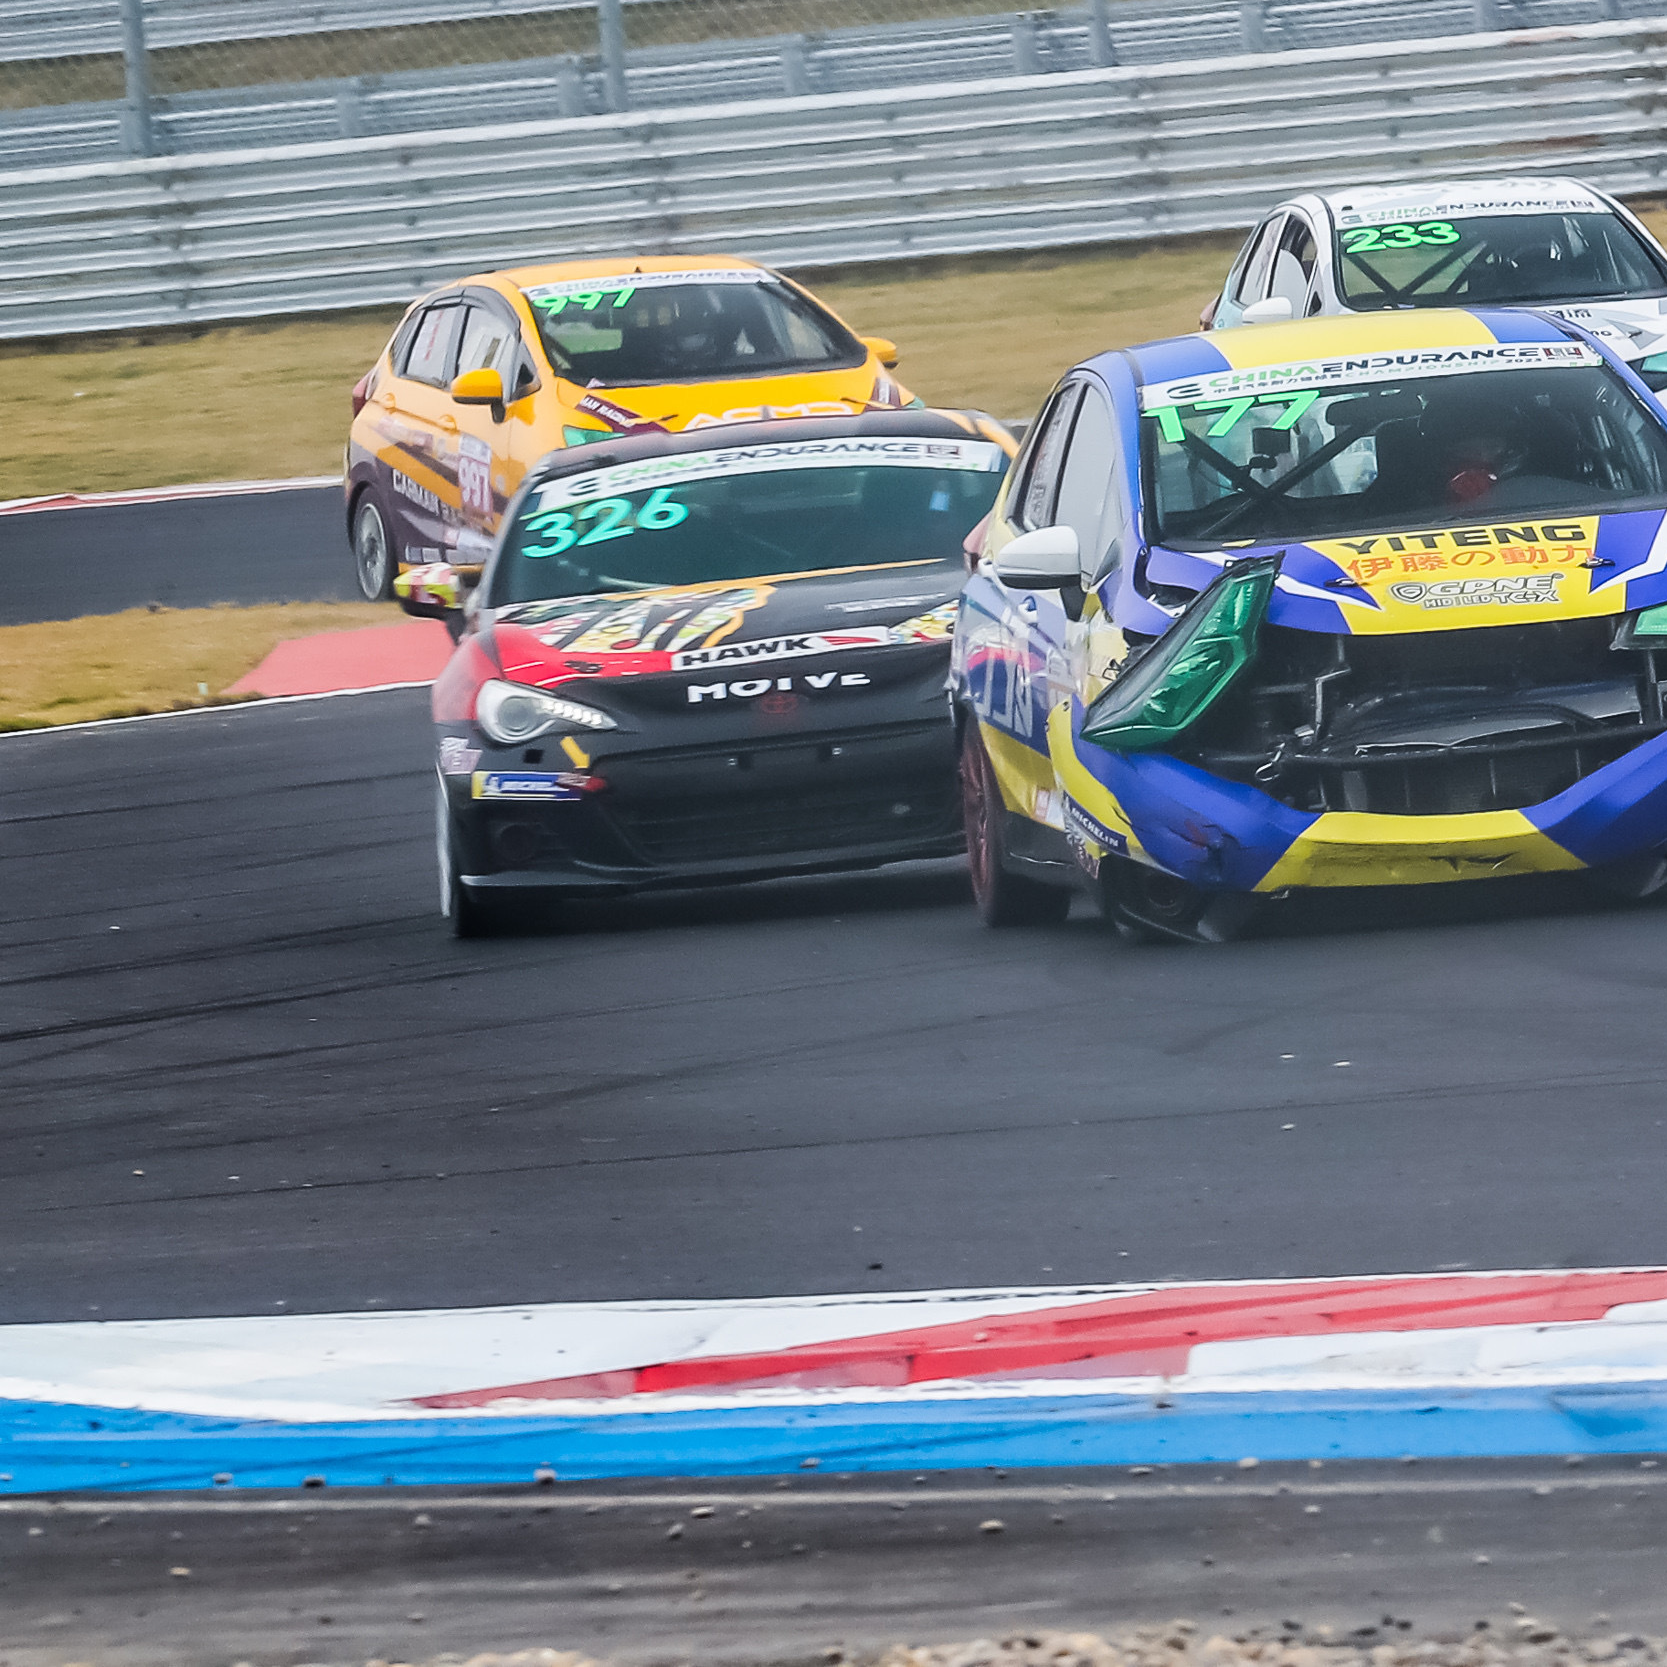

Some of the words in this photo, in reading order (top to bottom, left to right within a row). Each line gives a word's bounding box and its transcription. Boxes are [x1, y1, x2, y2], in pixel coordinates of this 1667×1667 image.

[1435, 199, 1568, 212] ENDURANCE
[1342, 221, 1461, 254] 233
[533, 287, 635, 316] 997
[1209, 365, 1319, 388] CHINA
[1321, 347, 1540, 374] ENDURANCE
[1141, 390, 1321, 443] 177
[609, 455, 709, 482] CHINA
[714, 442, 922, 464] ENDURANCE
[520, 487, 690, 558] 326
[1336, 524, 1586, 555] YITENG
[1347, 544, 1596, 580] 伊藤の動力
[1463, 593, 1493, 606] LED
[682, 637, 815, 666] HAWK
[1070, 807, 1119, 847] MICHELIN
